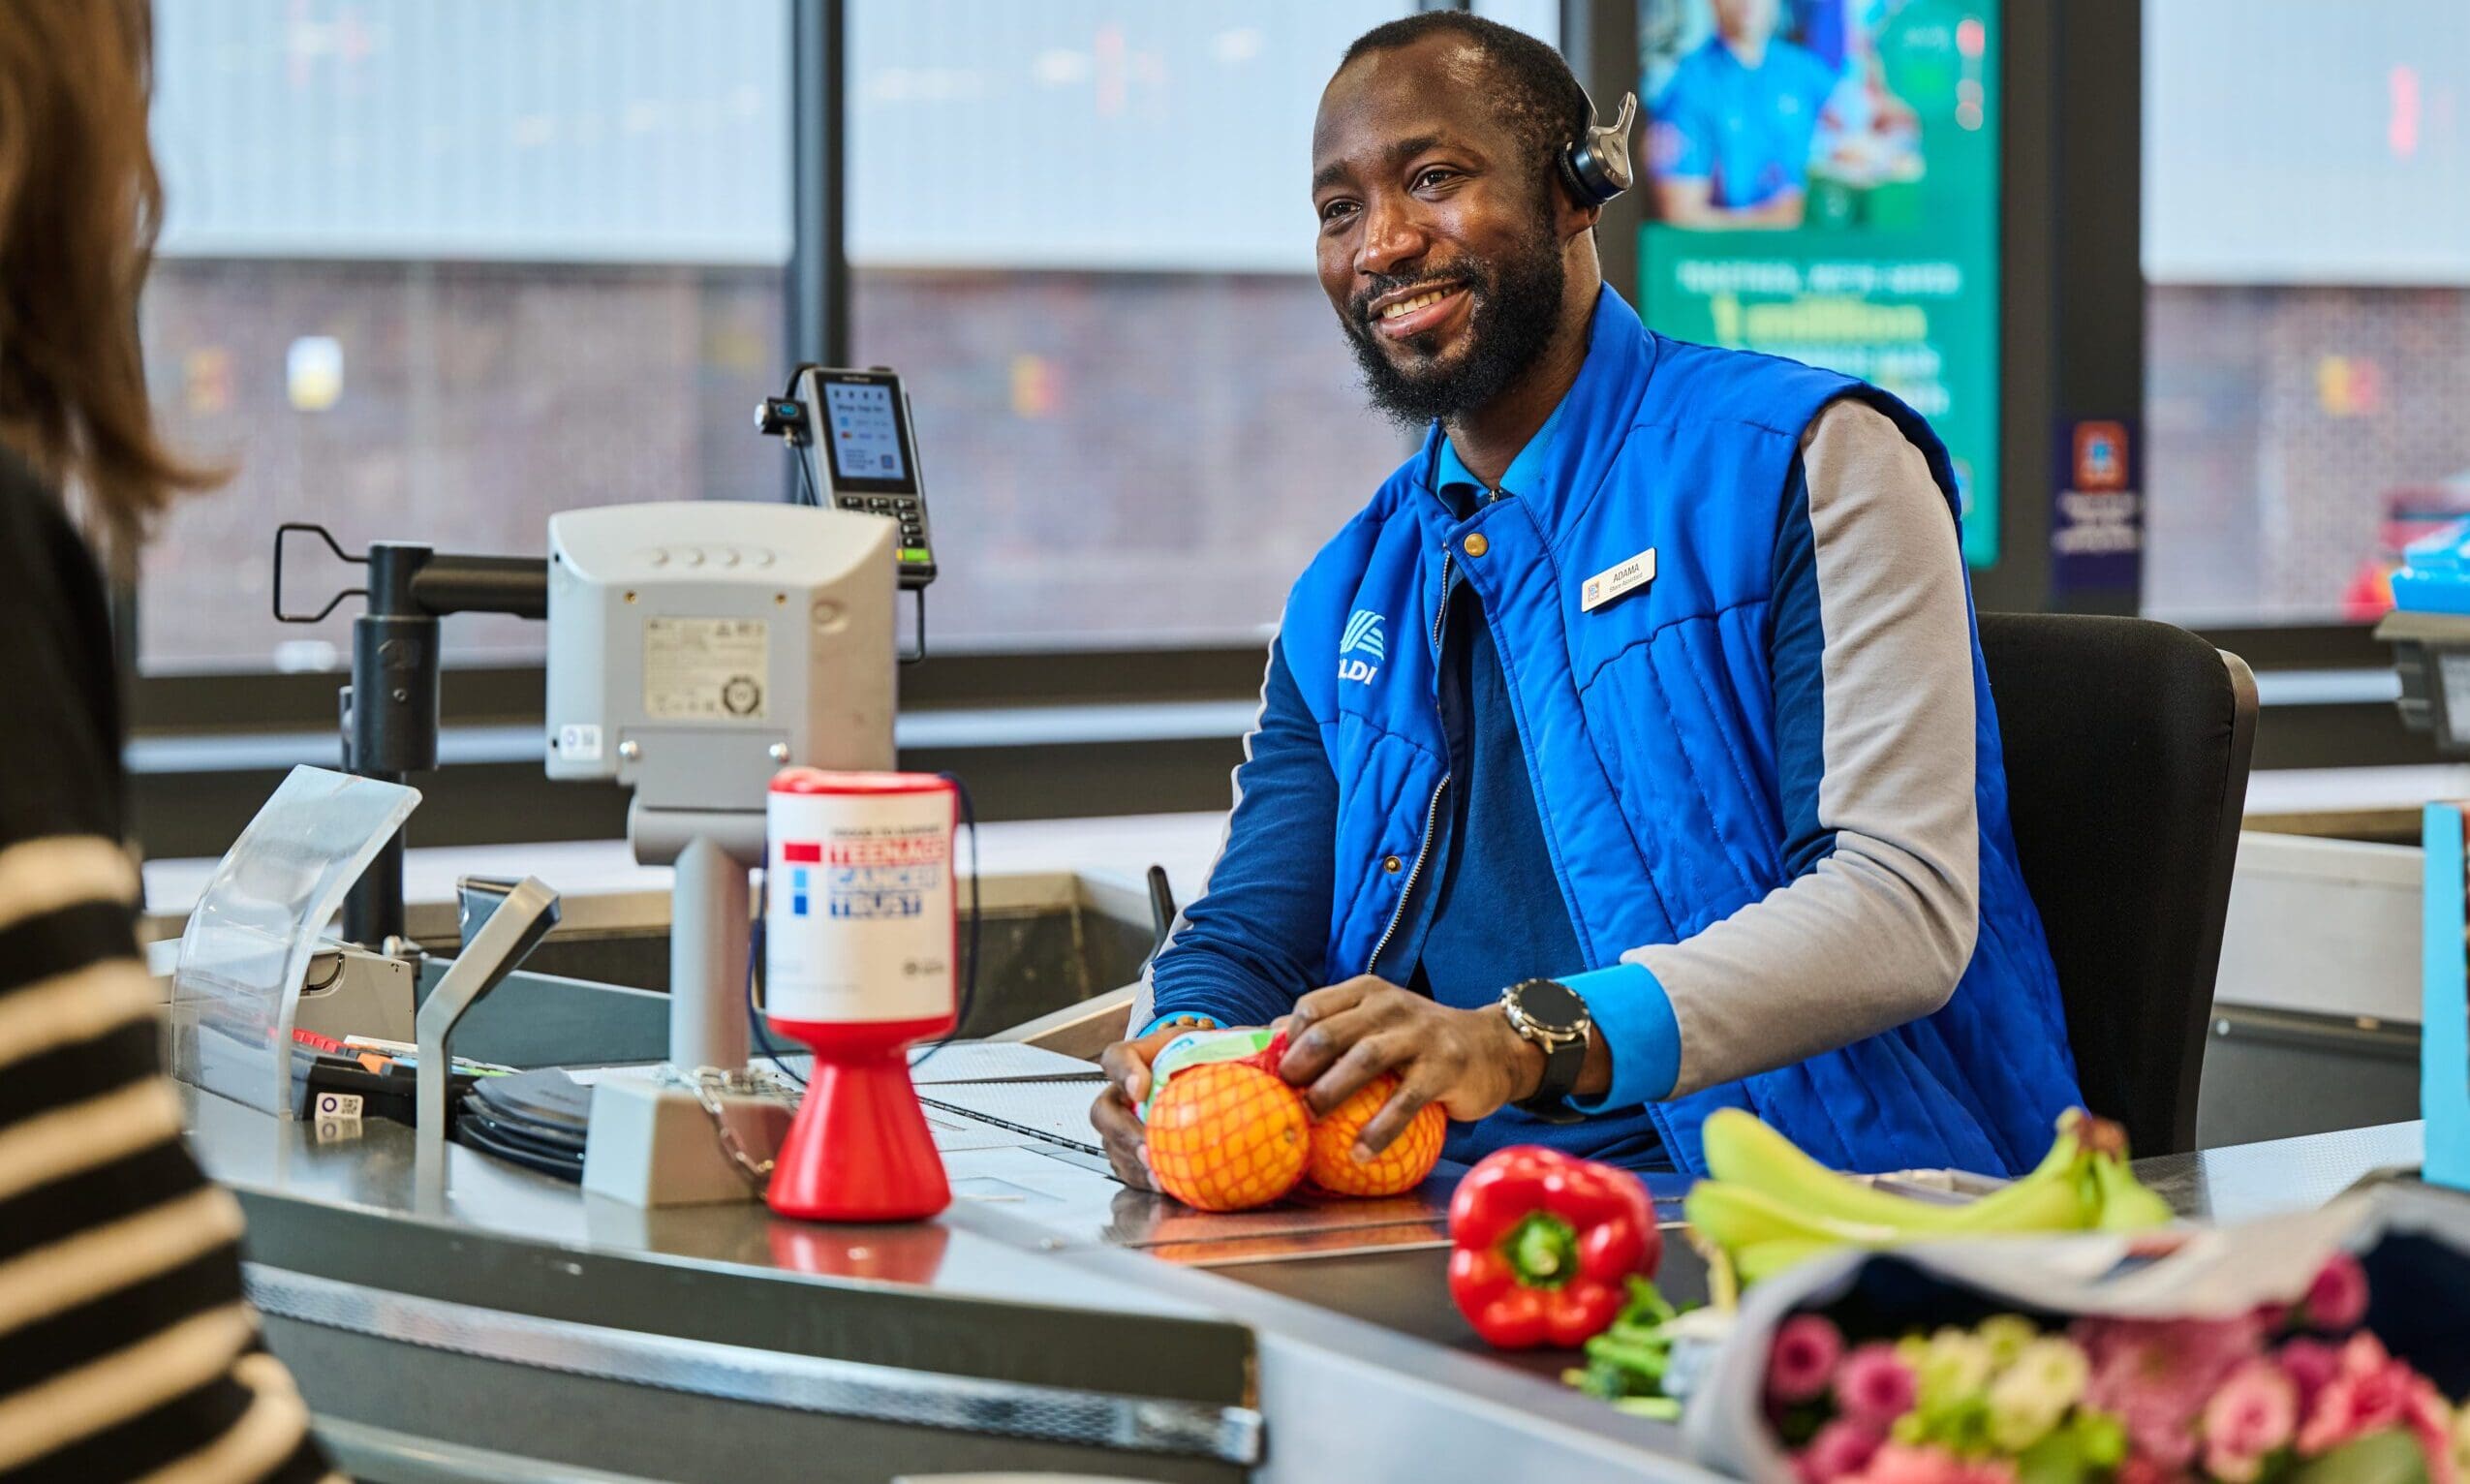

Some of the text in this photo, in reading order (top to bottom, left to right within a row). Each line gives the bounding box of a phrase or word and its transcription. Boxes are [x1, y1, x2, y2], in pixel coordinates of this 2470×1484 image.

[1613, 563, 1639, 583] ADAMA
[1338, 658, 1378, 685] LDI
[830, 839, 946, 866] TEENAGE
[830, 889, 922, 916] TRUST
